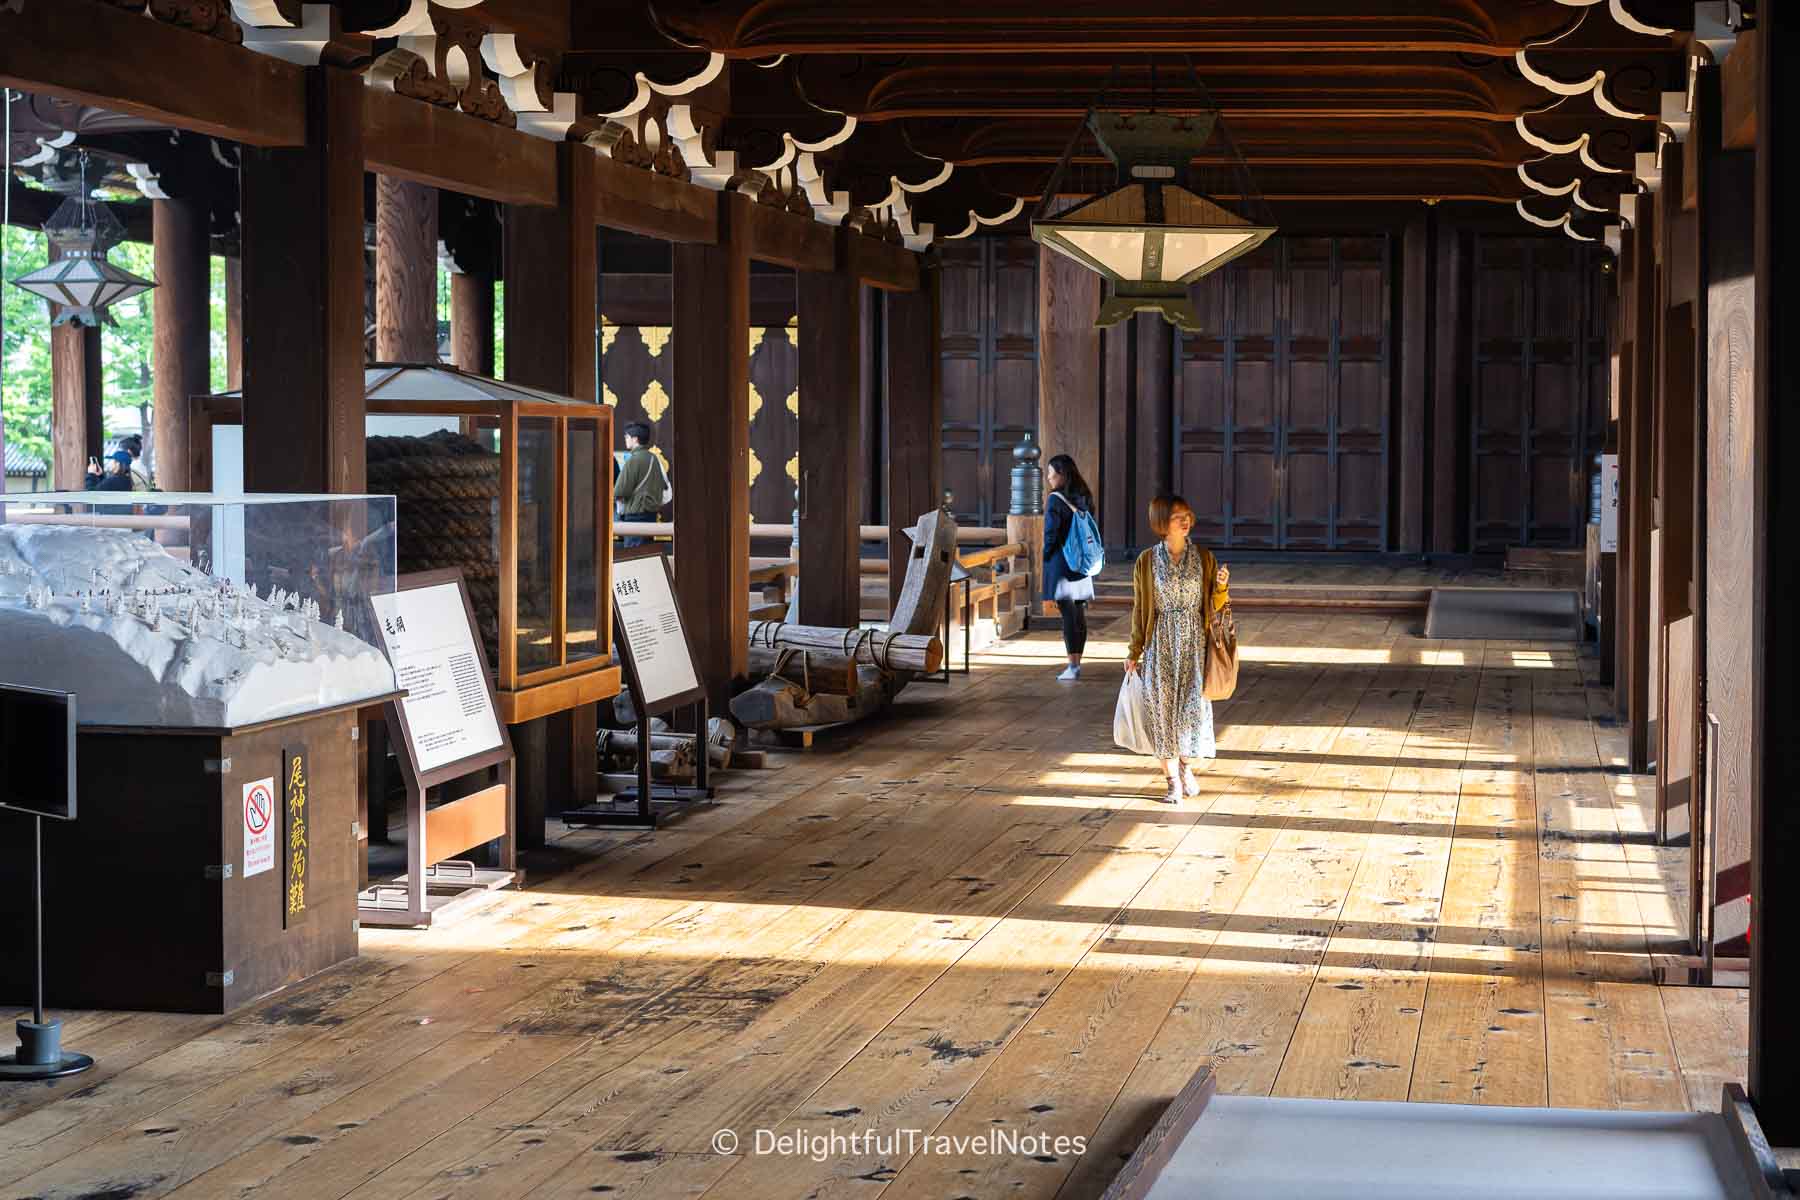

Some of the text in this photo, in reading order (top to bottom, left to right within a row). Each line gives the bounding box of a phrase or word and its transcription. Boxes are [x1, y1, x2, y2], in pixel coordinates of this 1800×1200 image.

[289, 756, 306, 913] 尾神嶽殉難
